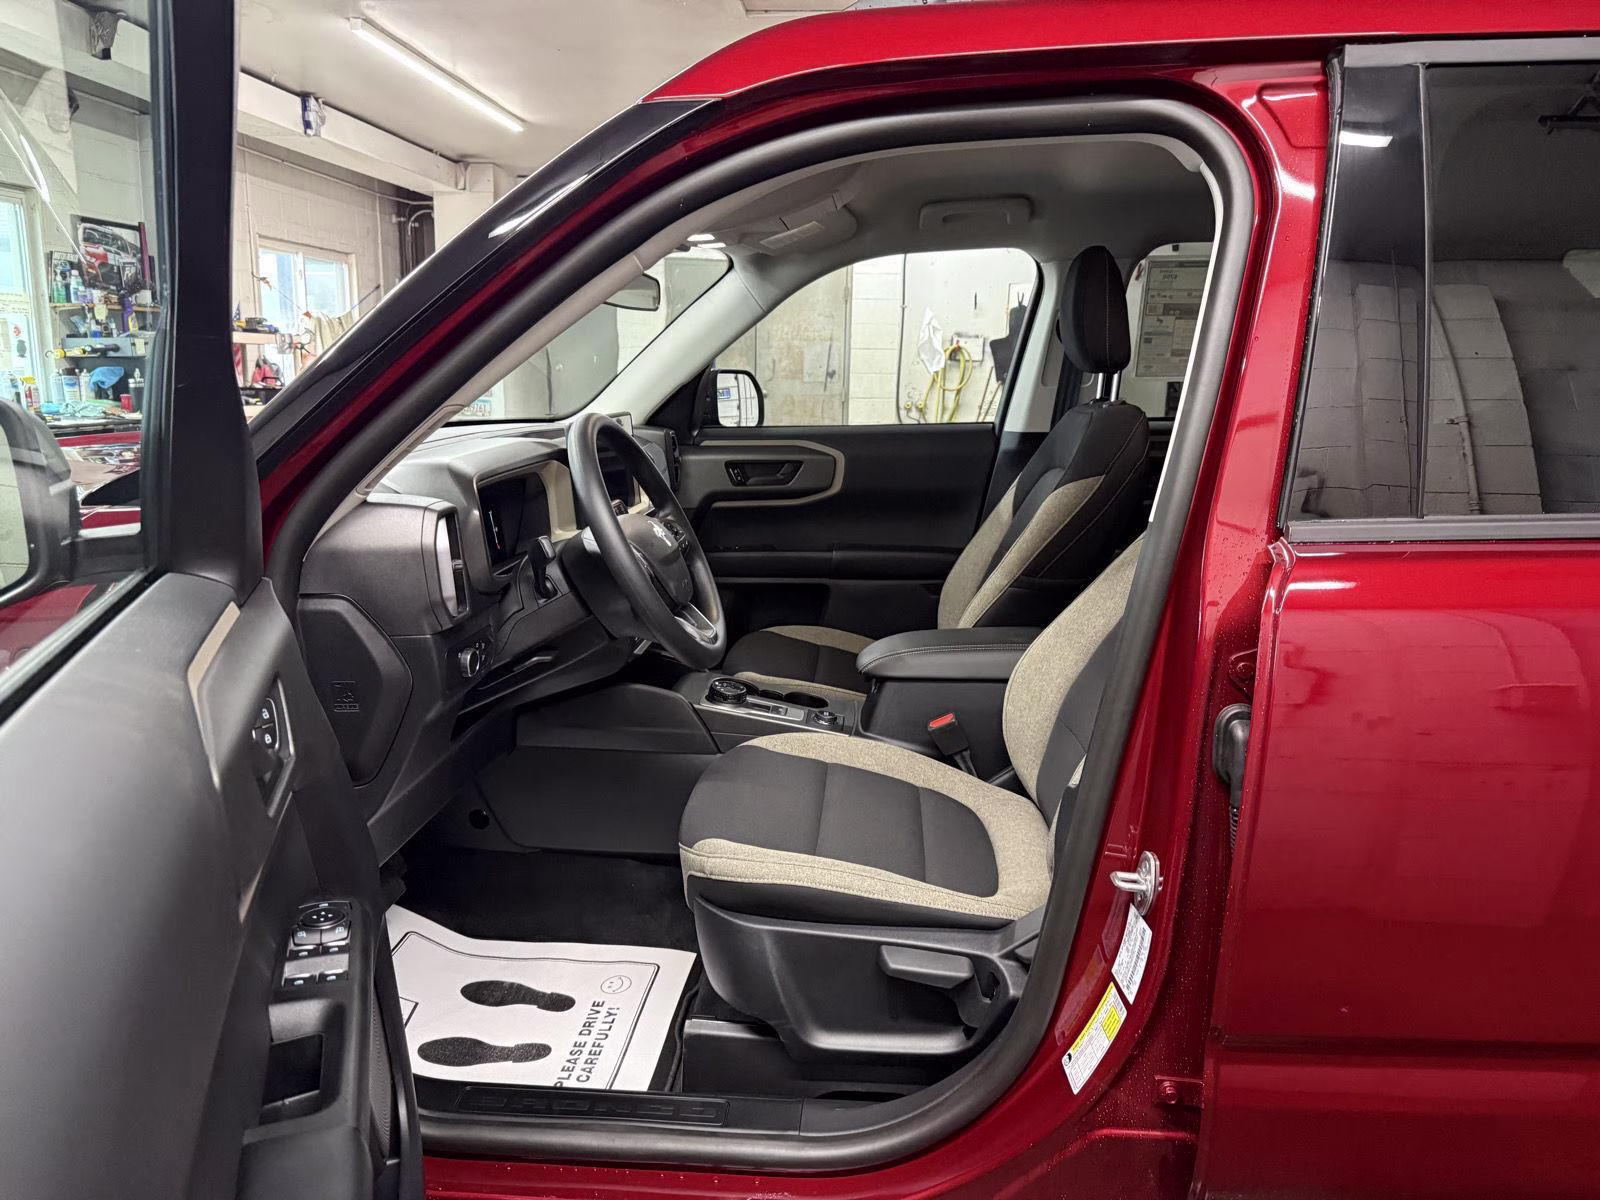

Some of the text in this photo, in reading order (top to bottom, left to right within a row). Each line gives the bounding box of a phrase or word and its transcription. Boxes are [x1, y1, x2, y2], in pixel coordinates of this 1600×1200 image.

[553, 1000, 606, 1088] PLEASE DRIVE
[575, 1007, 620, 1083] CAREFULLY!
